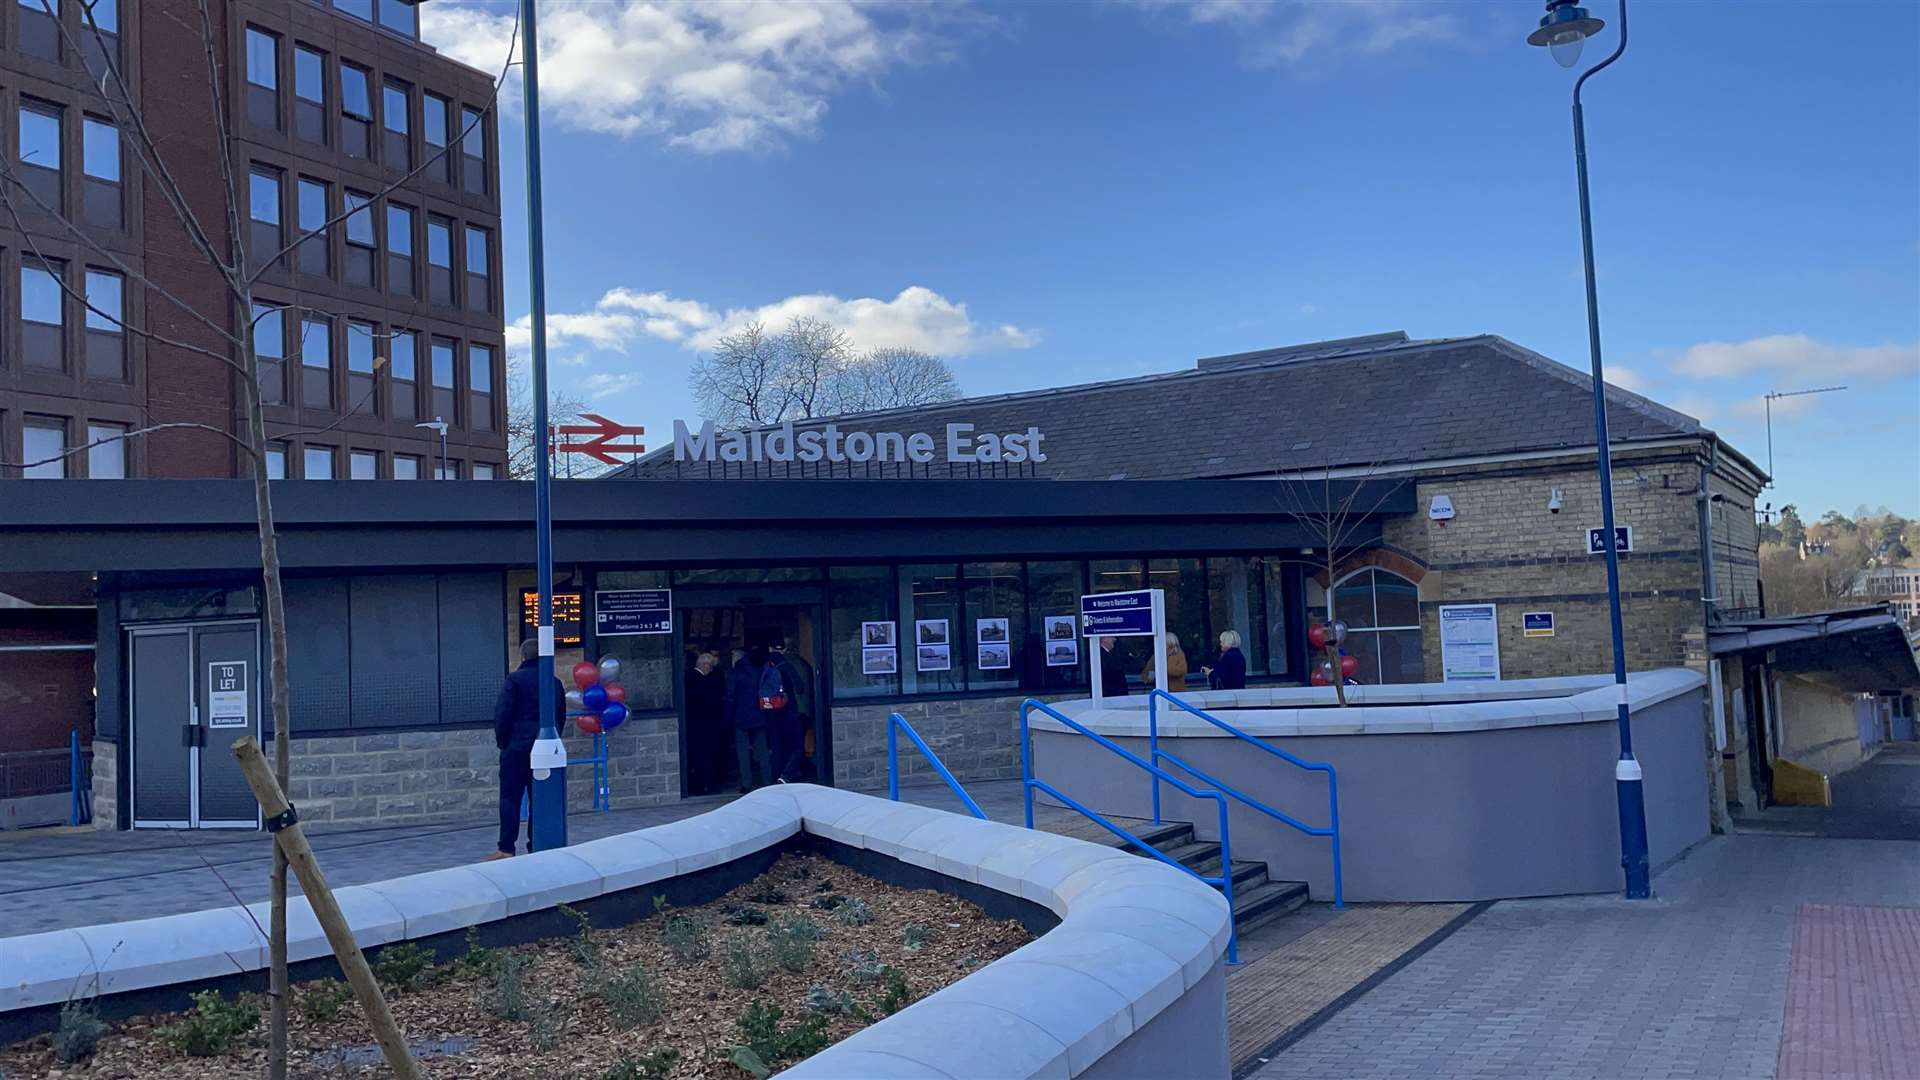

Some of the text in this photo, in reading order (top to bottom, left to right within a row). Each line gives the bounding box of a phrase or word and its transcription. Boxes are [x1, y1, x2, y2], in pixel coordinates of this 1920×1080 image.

[673, 419, 1048, 464] Maidstone East
[221, 667, 234, 677] TO
[220, 679, 236, 690] LET
